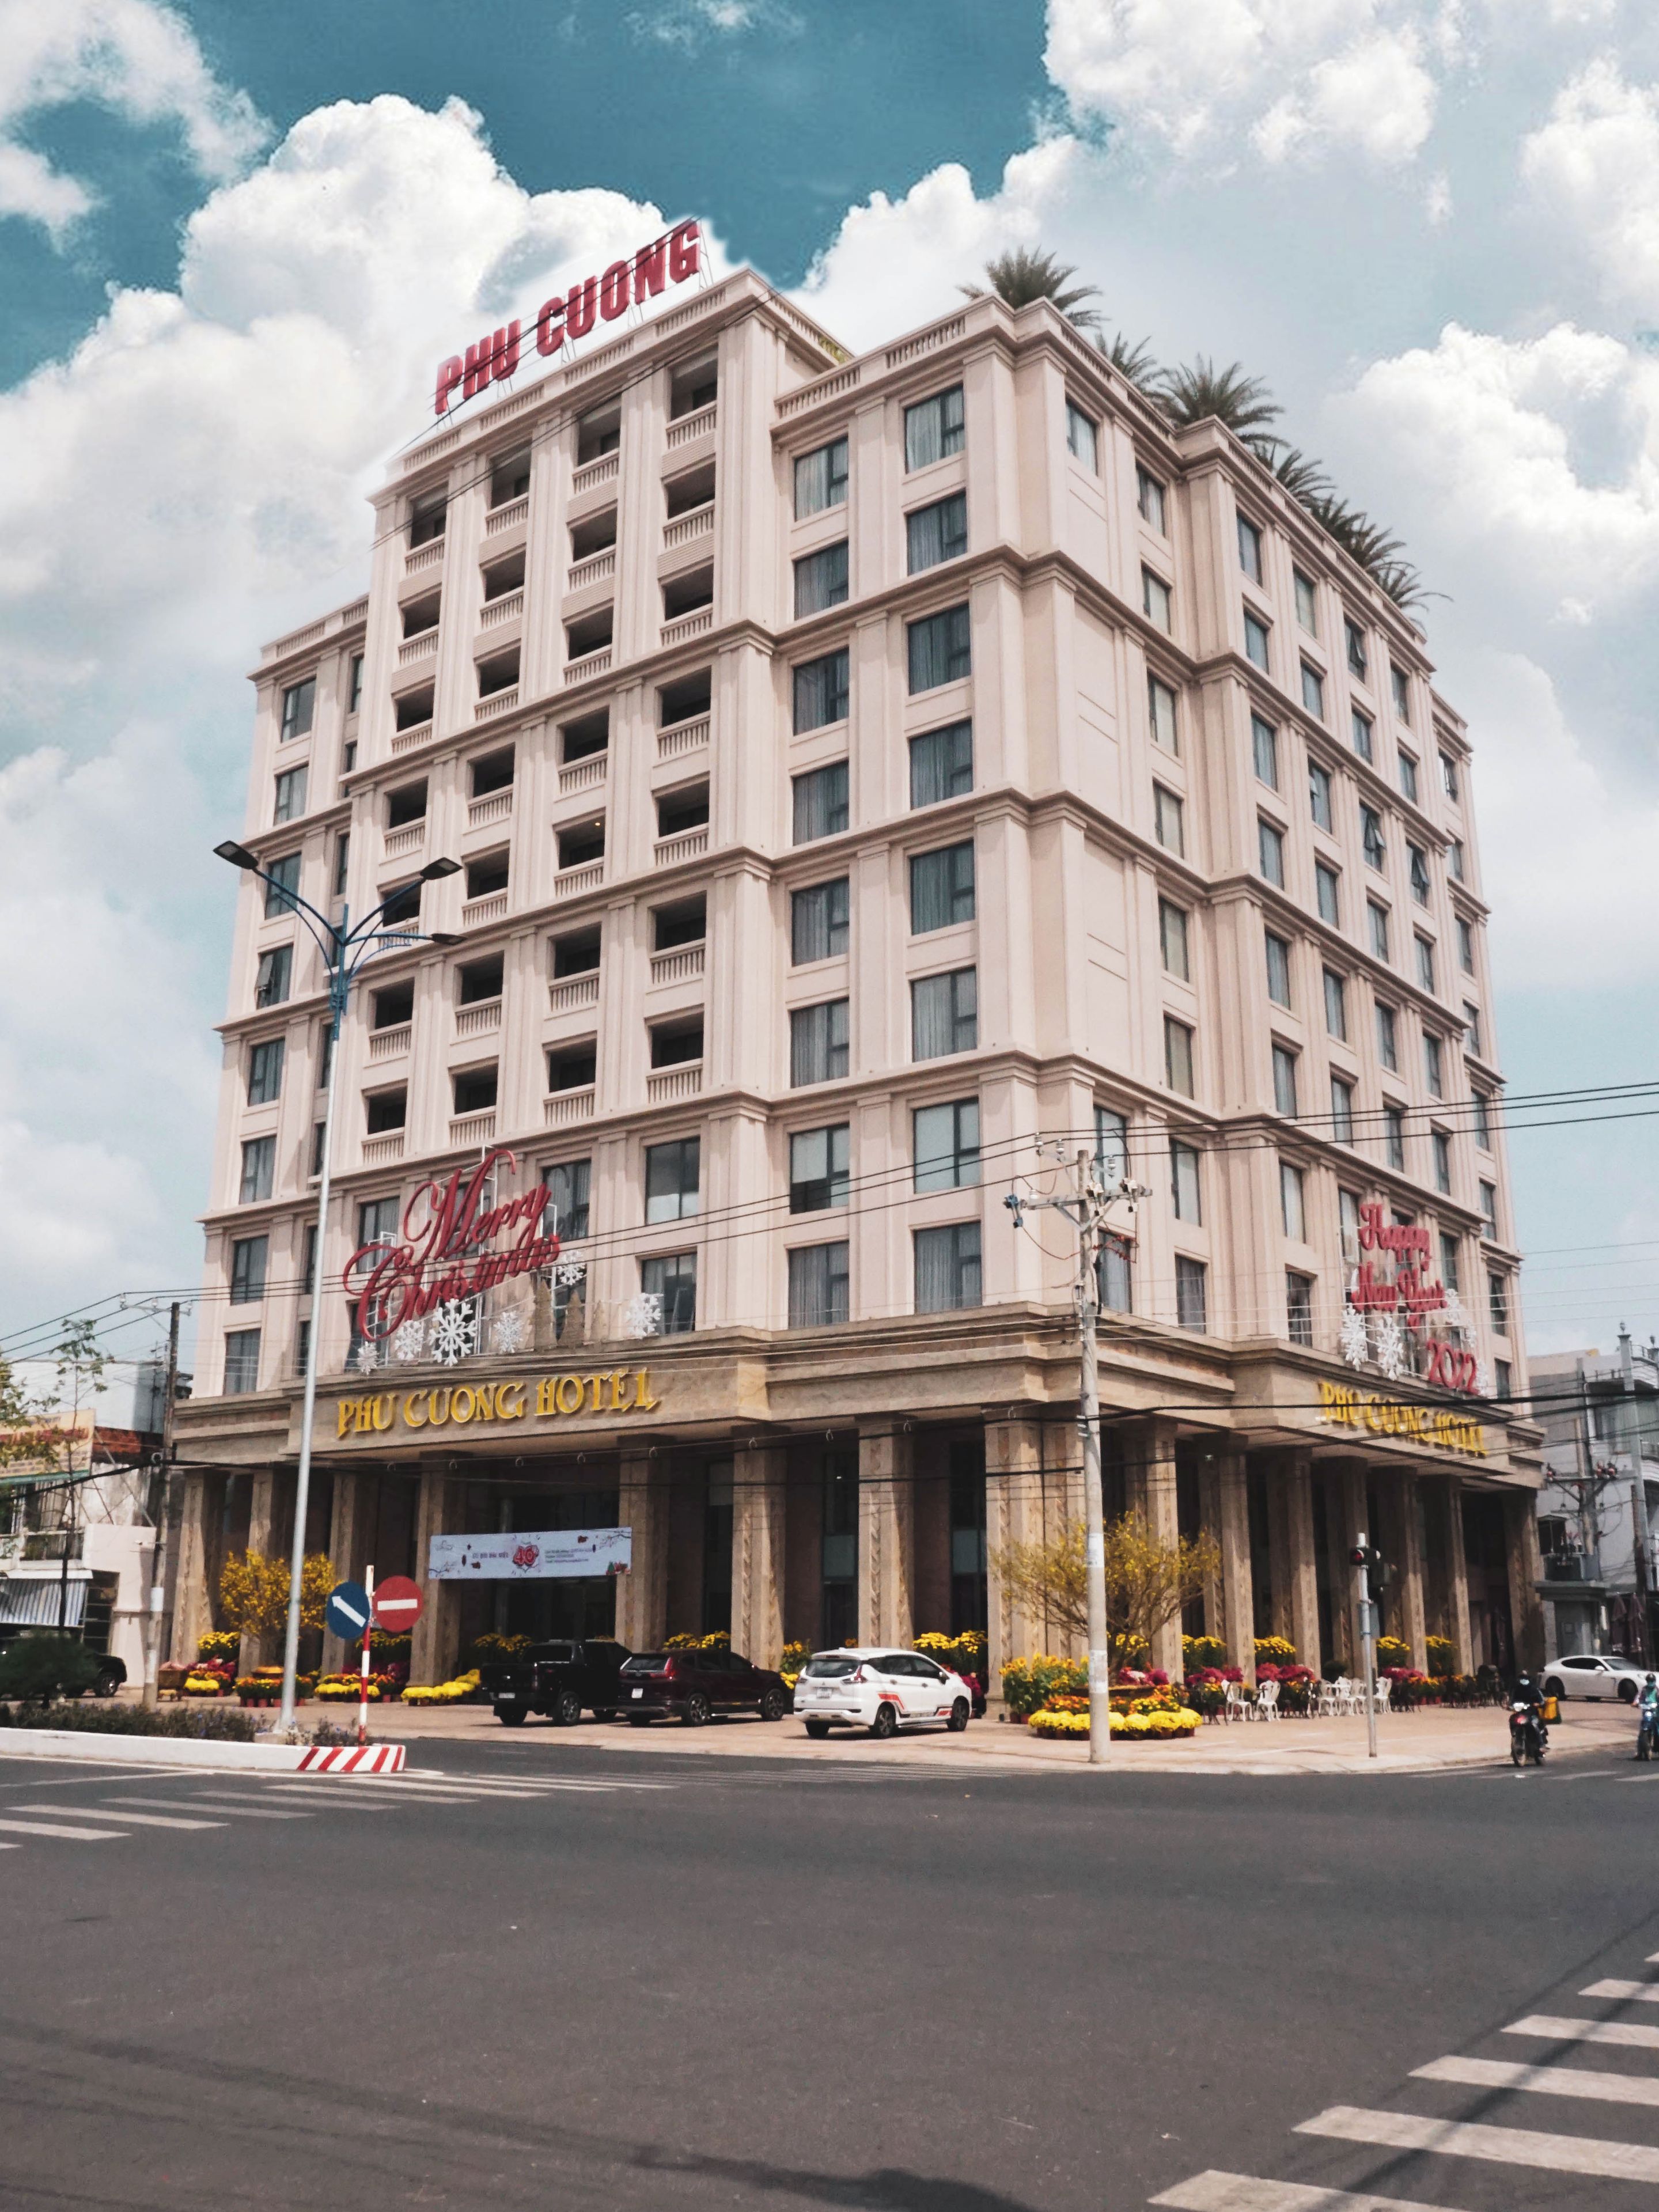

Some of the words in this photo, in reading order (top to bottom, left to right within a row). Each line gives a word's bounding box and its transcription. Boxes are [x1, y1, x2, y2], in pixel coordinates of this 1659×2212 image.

[434, 319, 521, 415] PHU
[537, 221, 700, 356] CUONG
[404, 1150, 551, 1266] Merry
[1359, 1203, 1432, 1271] Happy
[343, 1234, 560, 1342] Christmas
[1351, 1260, 1397, 1312] New
[1397, 1268, 1448, 1334] Year
[1426, 1338, 1479, 1395] 2022
[336, 1392, 396, 1439] PHU
[403, 1382, 525, 1427] CUONG
[533, 1368, 658, 1416] HOTEL
[1321, 1382, 1363, 1425] PHU
[1365, 1393, 1431, 1442] CUONG
[1433, 1411, 1488, 1455] HOTEL
